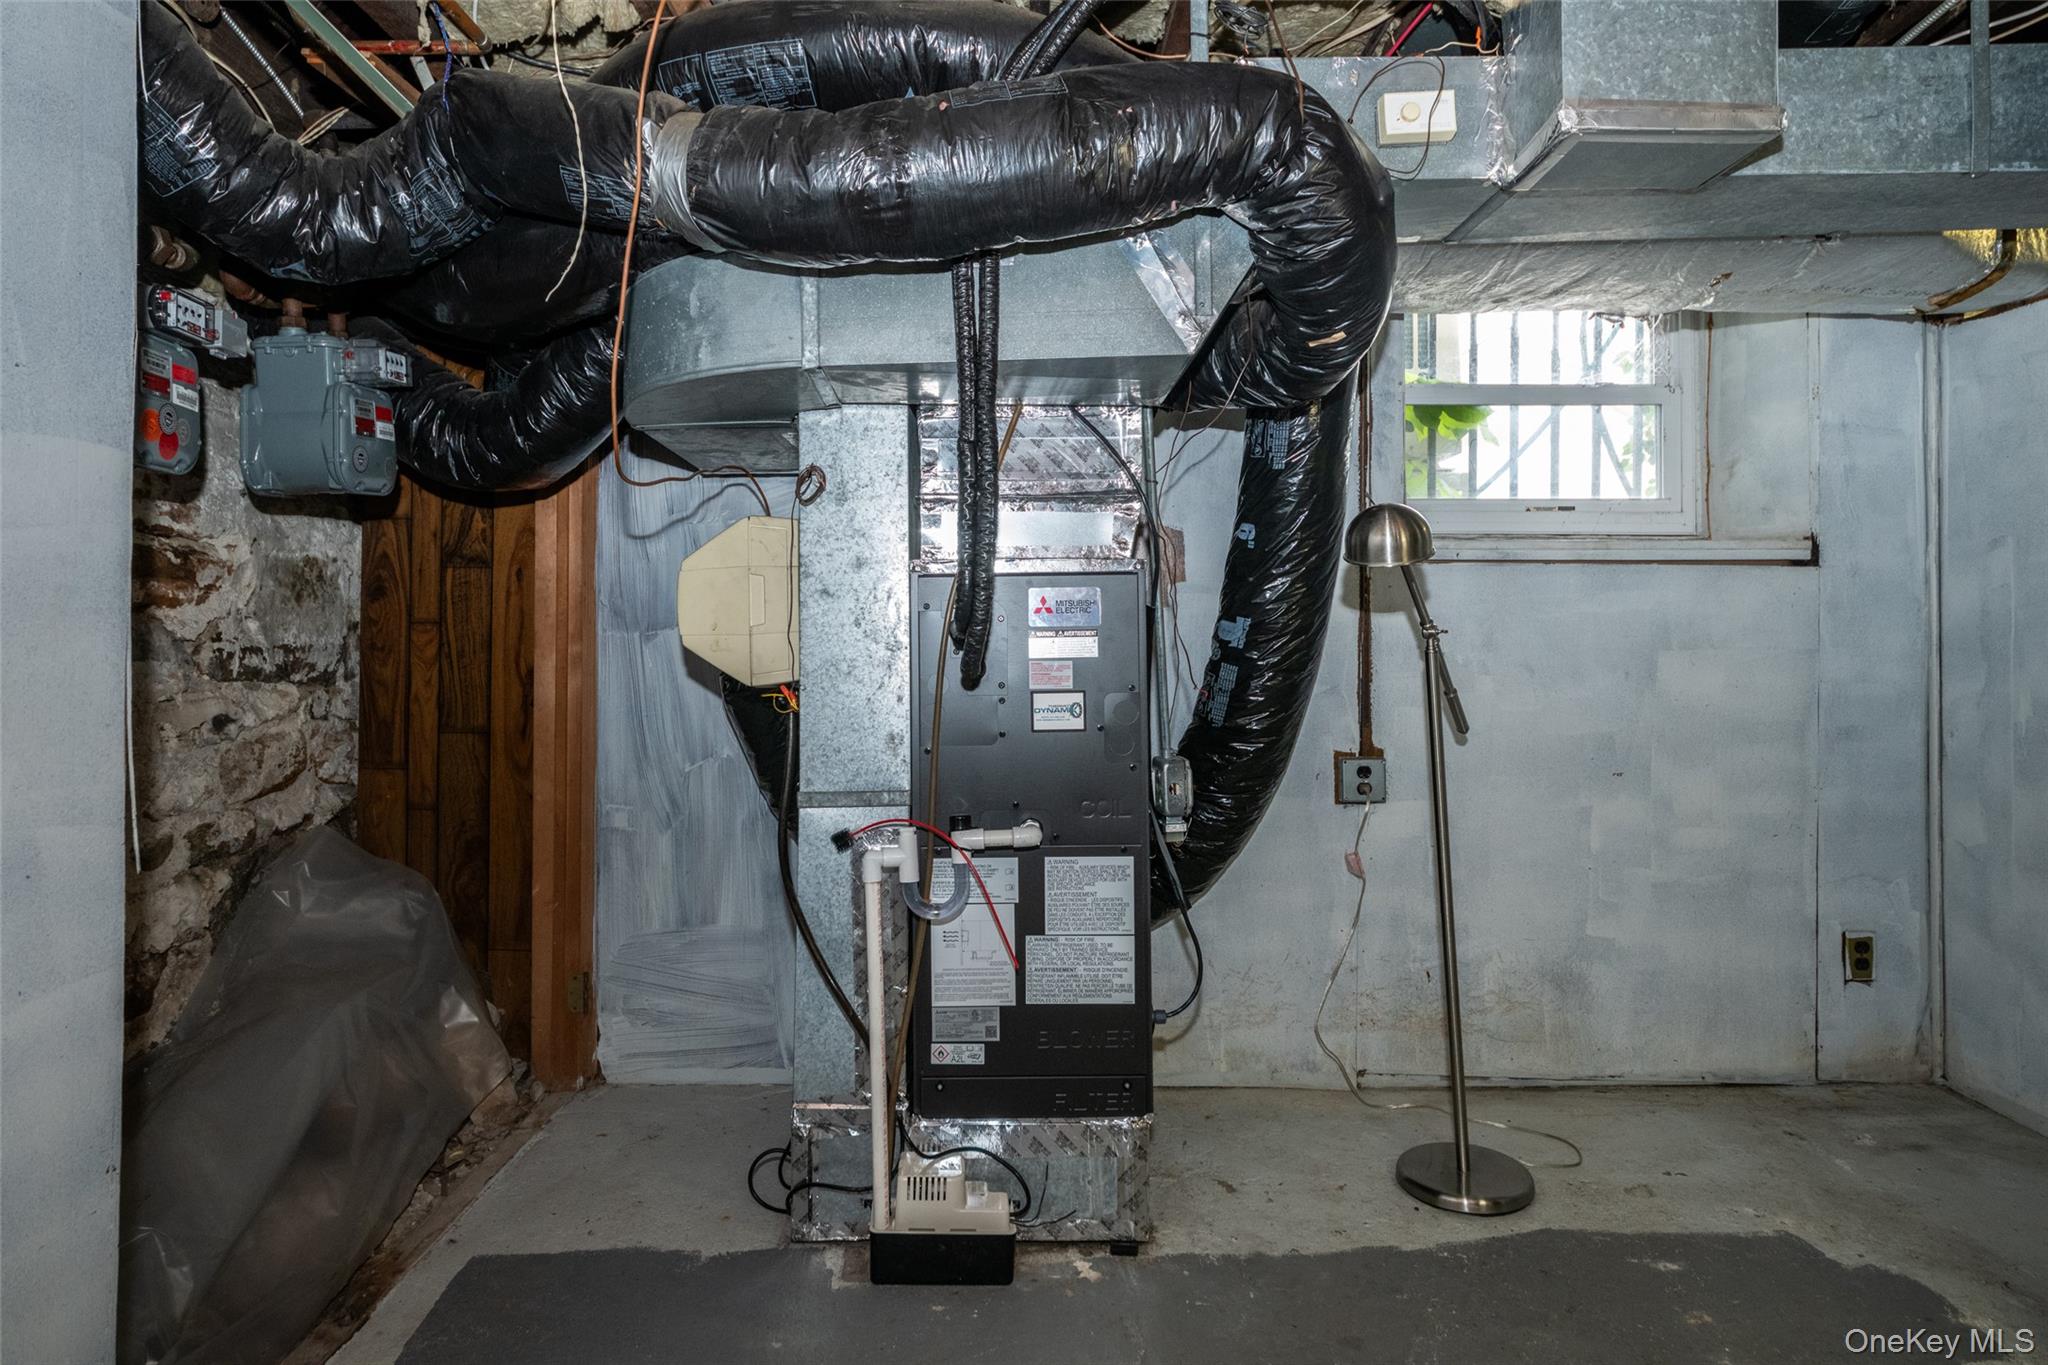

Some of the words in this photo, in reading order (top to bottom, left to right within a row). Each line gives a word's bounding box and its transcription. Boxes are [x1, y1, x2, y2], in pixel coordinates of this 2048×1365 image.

[1056, 599, 1097, 607] MITSUBISH
[1056, 606, 1092, 614] ELECTRIC
[951, 1055, 965, 1063] A2L
